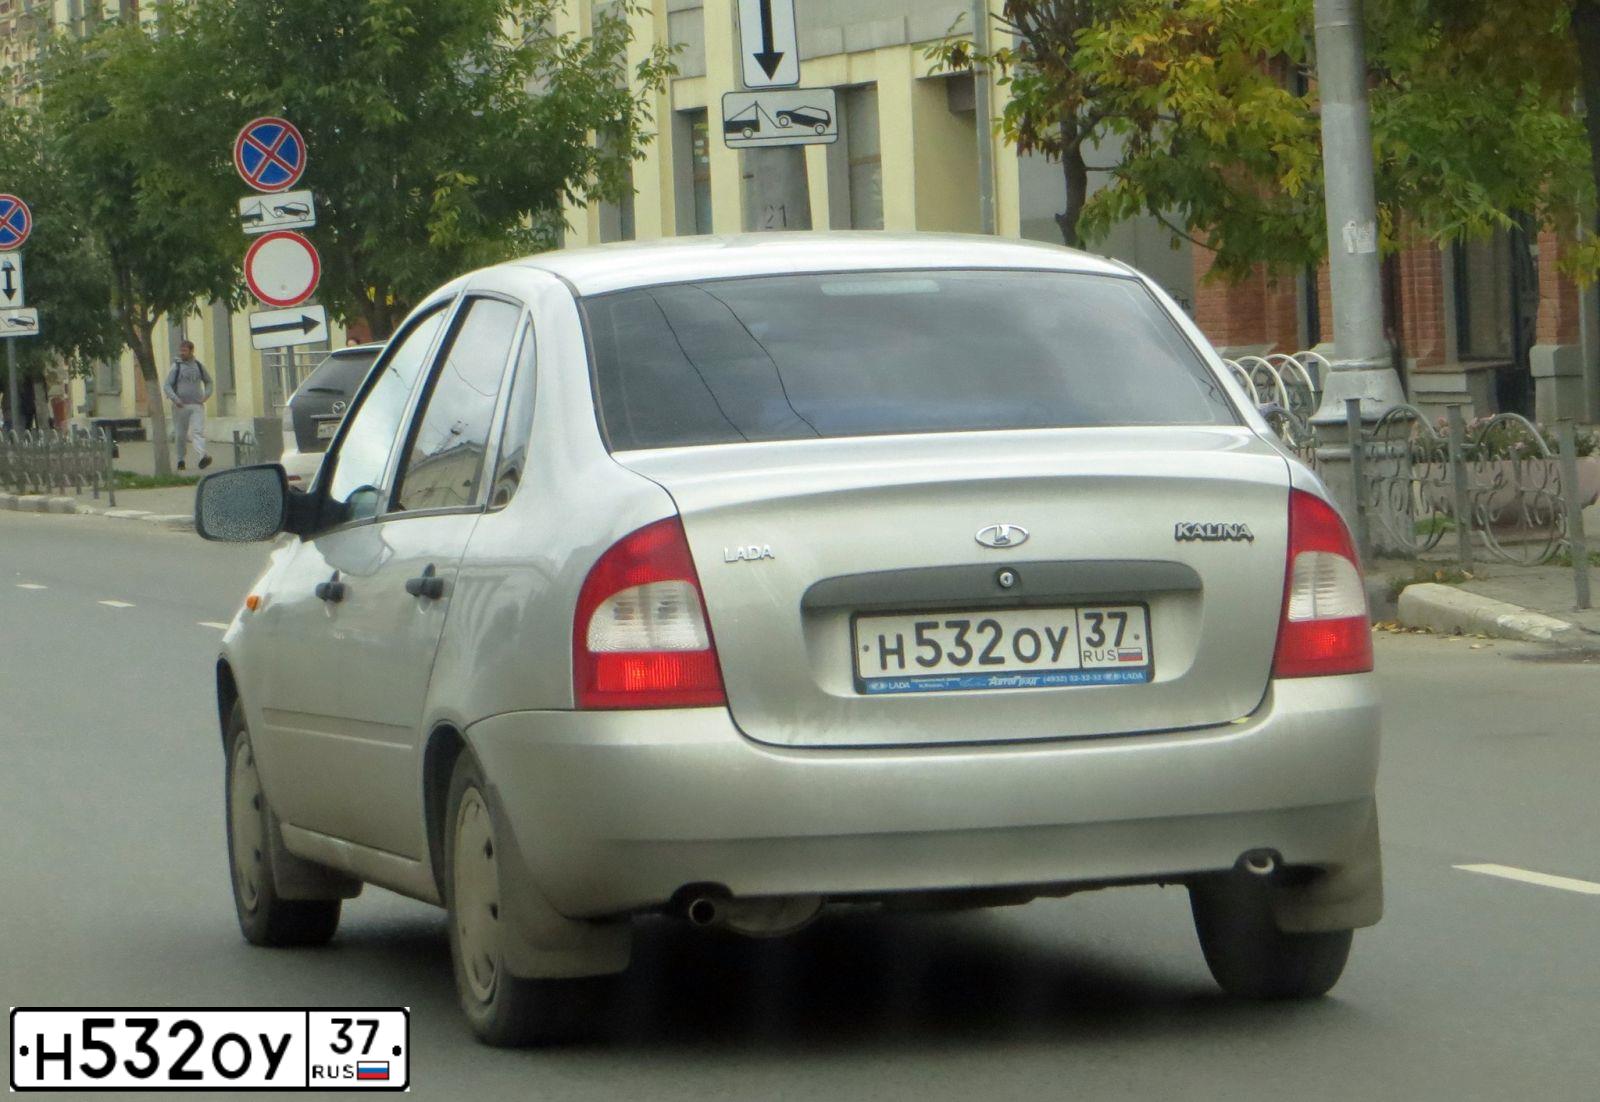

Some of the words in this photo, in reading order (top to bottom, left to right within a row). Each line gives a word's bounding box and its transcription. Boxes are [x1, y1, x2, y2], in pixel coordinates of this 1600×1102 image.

[1175, 523, 1254, 541] KALINA
[723, 545, 775, 563] LADA
[1084, 611, 1127, 648] 37
[1083, 649, 1116, 662] RUS
[1121, 671, 1144, 680] LADA
[888, 681, 911, 690] LADA
